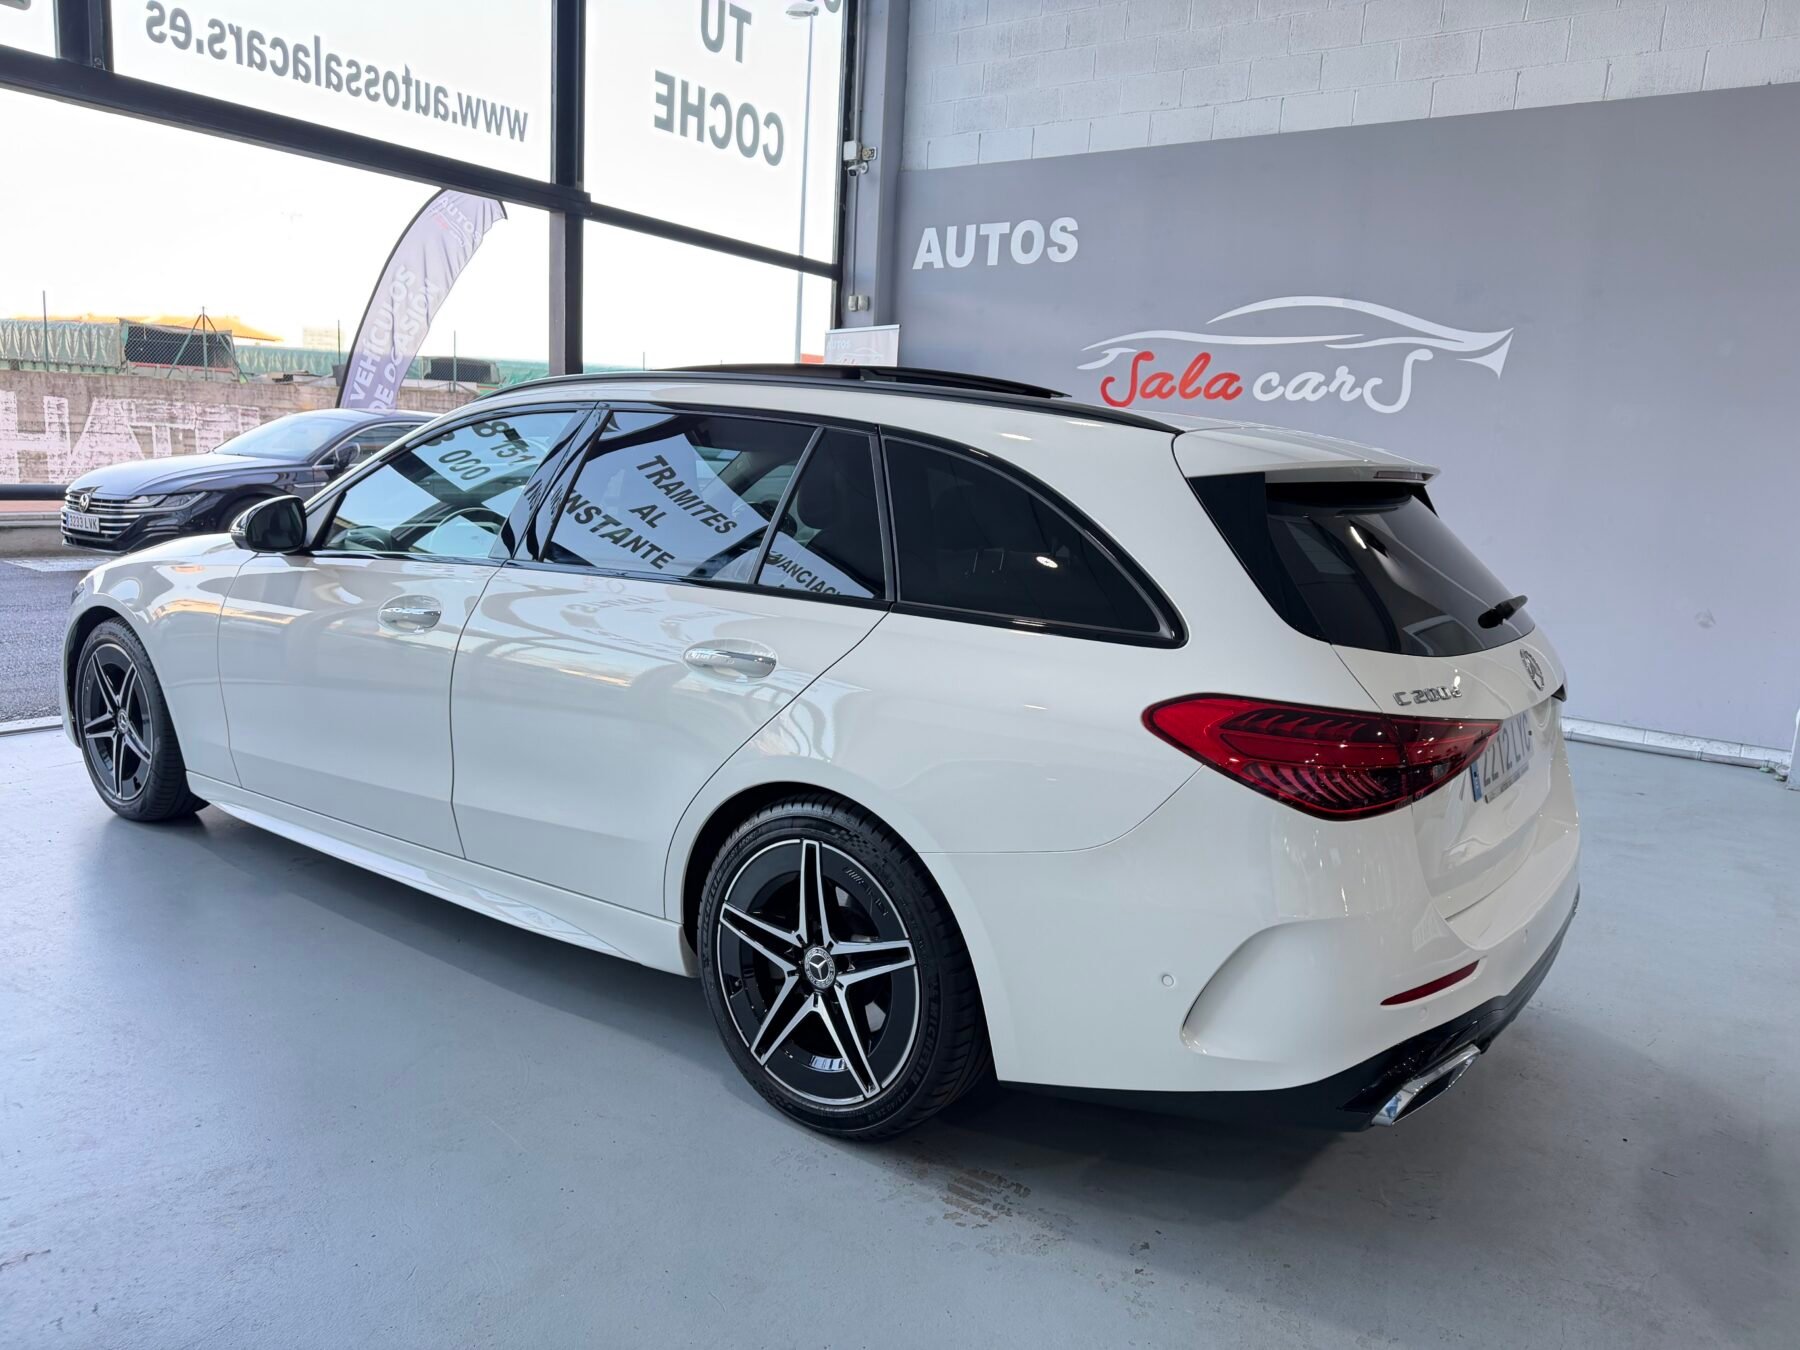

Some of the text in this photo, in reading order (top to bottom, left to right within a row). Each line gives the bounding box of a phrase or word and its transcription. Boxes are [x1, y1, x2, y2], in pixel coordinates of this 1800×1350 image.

[912, 216, 1079, 270] AUTOS
[1101, 350, 1243, 408] Sala
[629, 504, 667, 529] AL
[636, 454, 738, 535] TRAMITES
